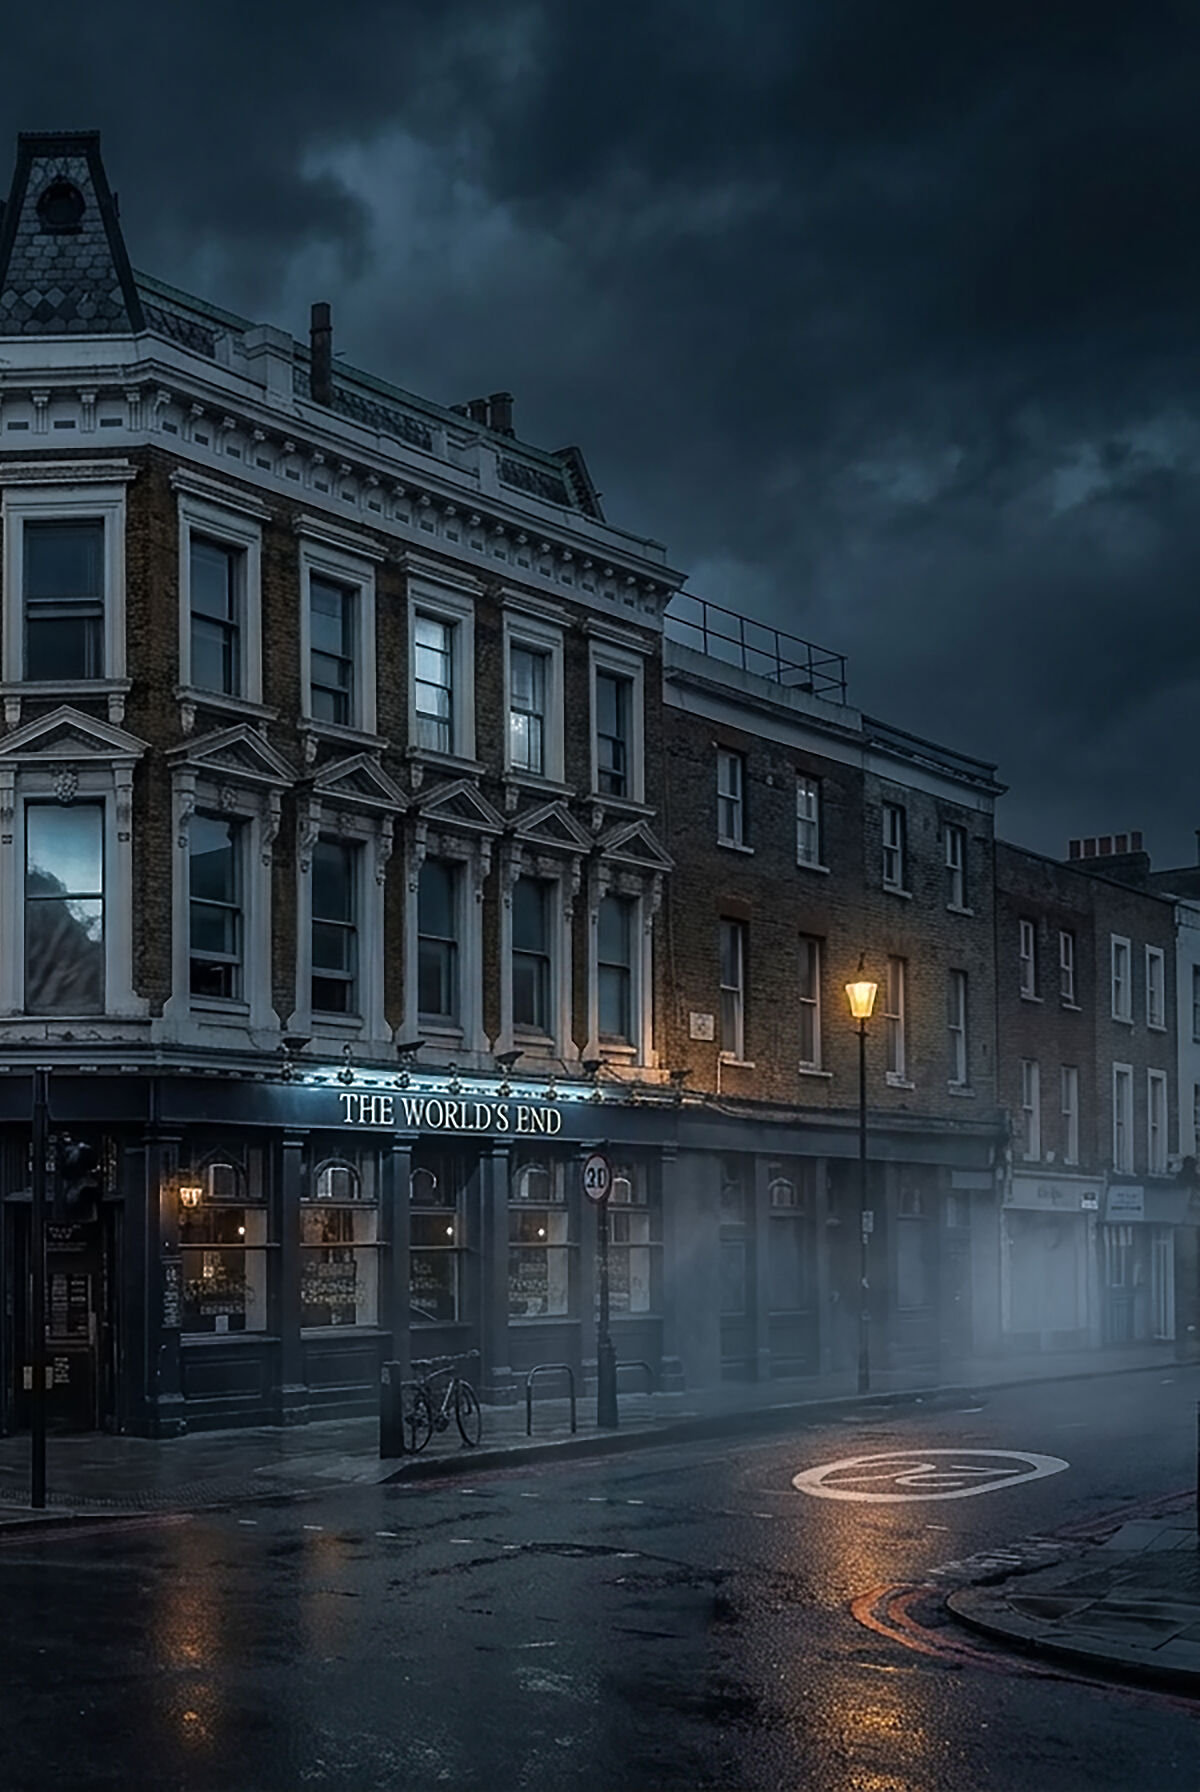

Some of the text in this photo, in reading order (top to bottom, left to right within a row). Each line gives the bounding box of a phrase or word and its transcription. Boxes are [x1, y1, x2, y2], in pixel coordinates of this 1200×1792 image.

[339, 1093, 561, 1135] THE WORLD'S END
[587, 1167, 606, 1188] 20
